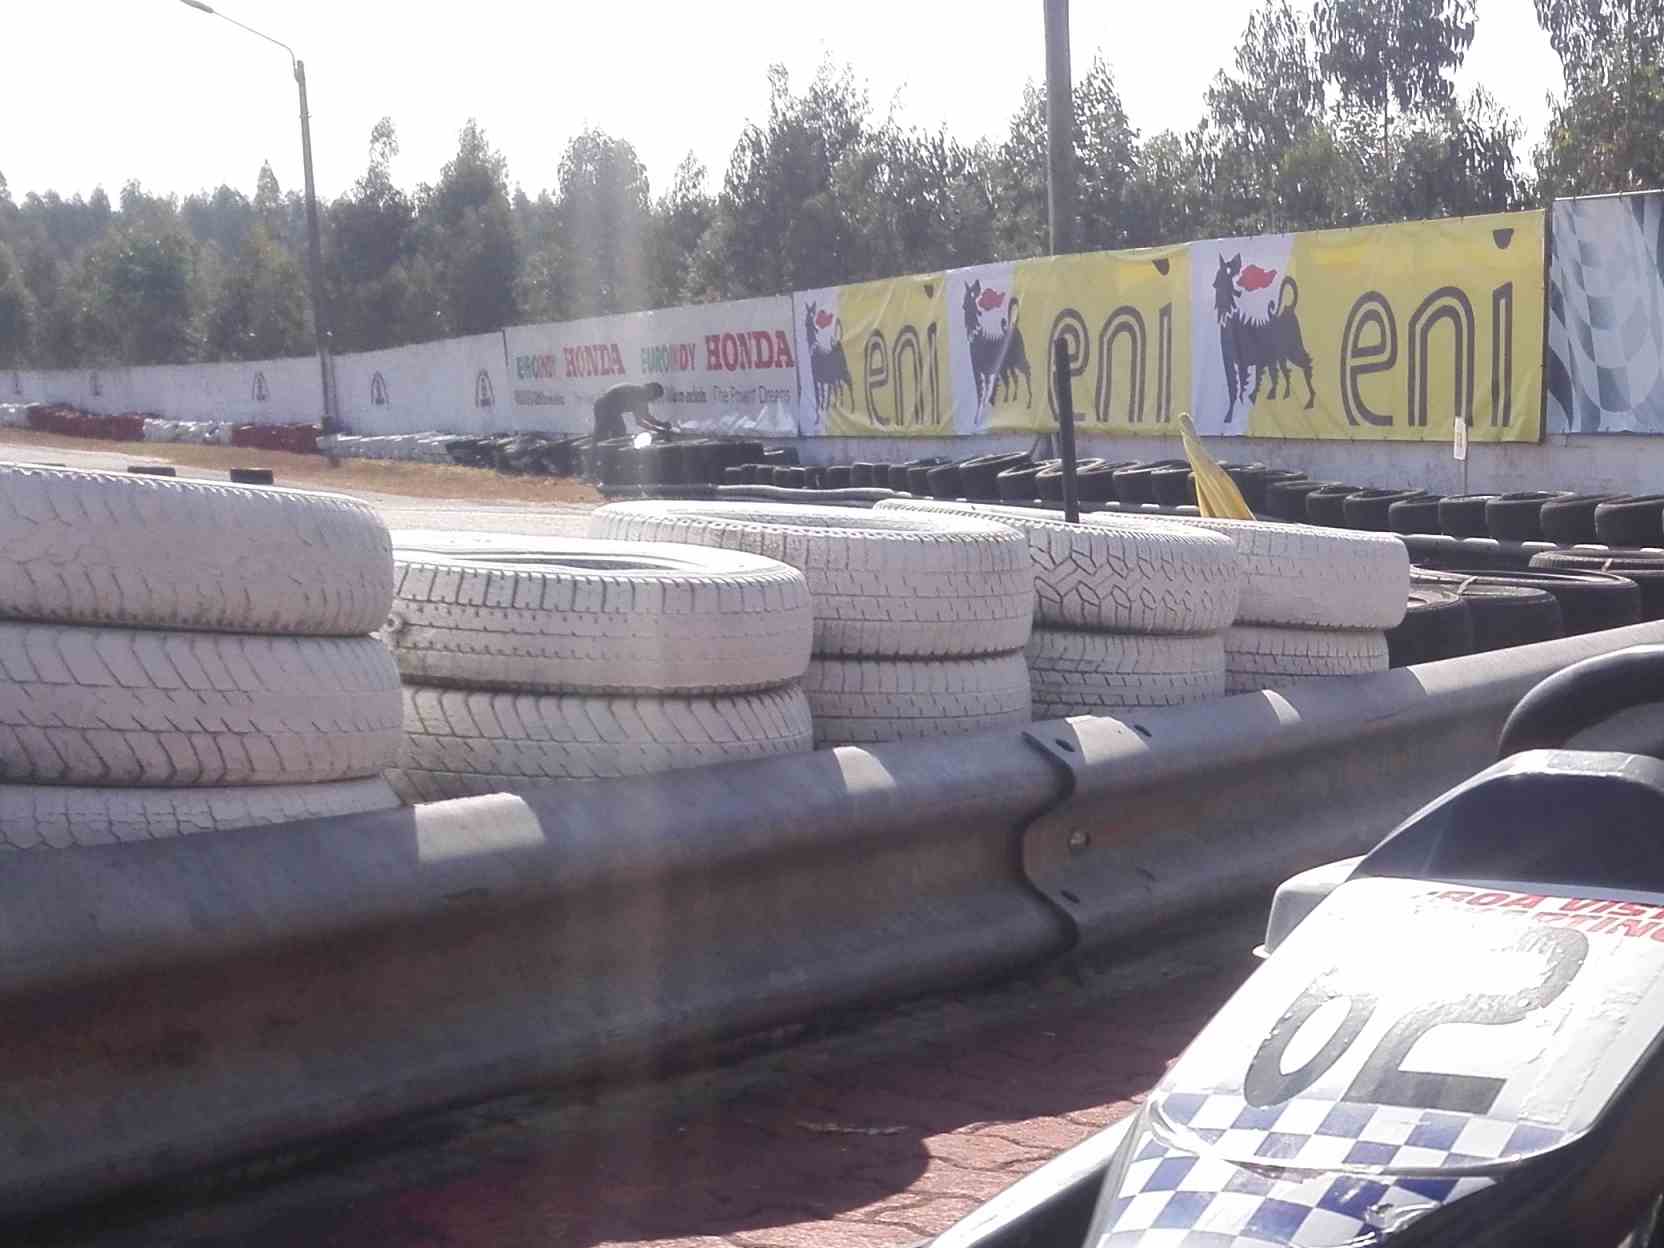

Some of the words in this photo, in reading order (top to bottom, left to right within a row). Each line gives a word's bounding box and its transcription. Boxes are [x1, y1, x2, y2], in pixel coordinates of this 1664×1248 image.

[563, 343, 625, 378] HONDA
[704, 330, 795, 372] HONDA
[864, 284, 941, 426] eni
[1047, 256, 1172, 423] eni
[1340, 228, 1514, 427] eni
